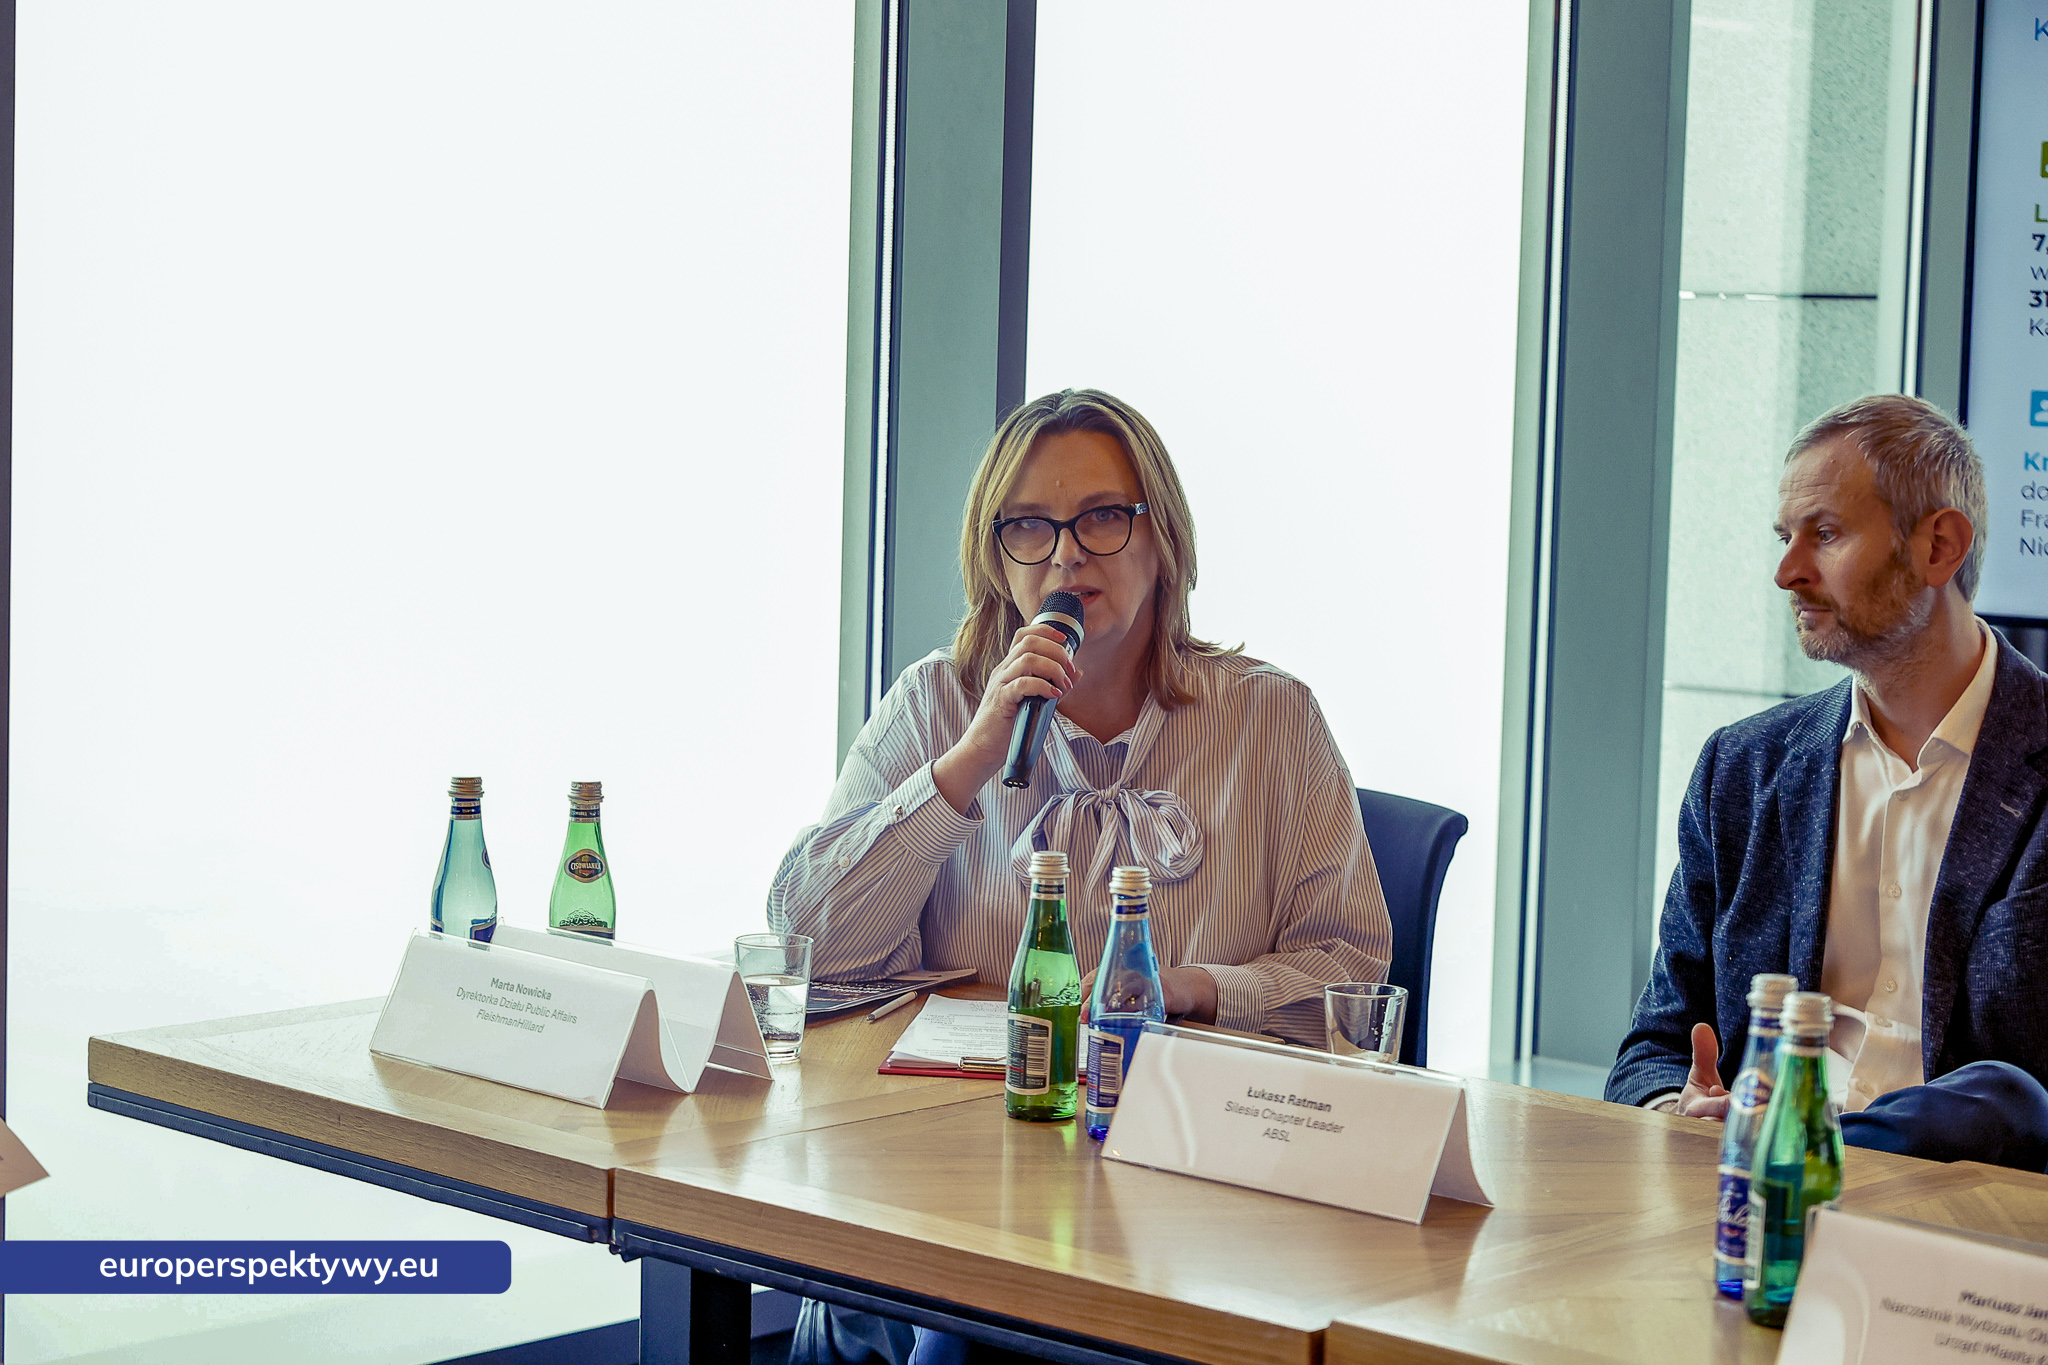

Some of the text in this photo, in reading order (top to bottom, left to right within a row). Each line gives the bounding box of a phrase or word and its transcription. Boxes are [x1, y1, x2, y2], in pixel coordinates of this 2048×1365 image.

[490, 977, 552, 1001] Marta Nowicka
[456, 986, 578, 1025] Dyrektorka Działu Public Affairs
[1246, 1086, 1332, 1113] Łukasz Ratman
[1224, 1100, 1345, 1134] Silesia Chapter Leader
[1262, 1127, 1291, 1142] ABSL
